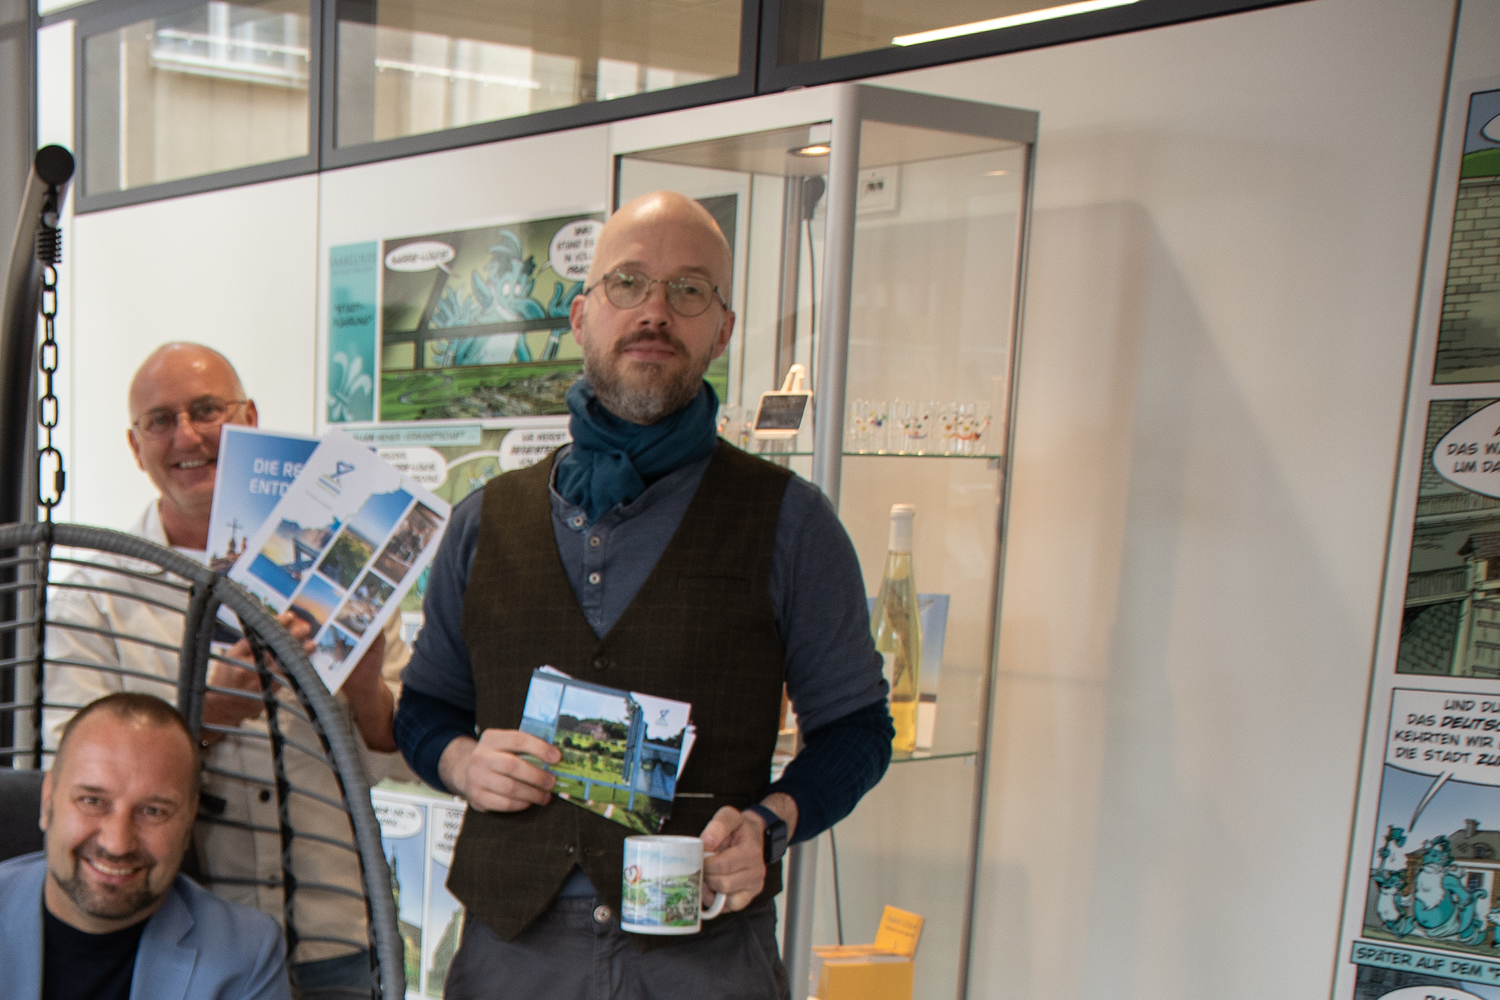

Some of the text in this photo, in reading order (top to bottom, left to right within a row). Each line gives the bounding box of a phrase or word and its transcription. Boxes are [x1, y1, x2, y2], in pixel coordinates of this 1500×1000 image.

[1446, 442, 1479, 456] DAS
[253, 457, 279, 476] DIE
[1453, 460, 1478, 474] UM
[1443, 699, 1476, 711] UND
[1406, 713, 1437, 726] DAS
[1394, 729, 1460, 746] KEHRTEN
[1465, 736, 1495, 748] WIR
[1395, 746, 1418, 760] DIE
[1423, 748, 1473, 764] STADT
[1355, 946, 1413, 966] SPÄTER
[1415, 956, 1446, 970] AUF
[1450, 961, 1483, 977] DEM
